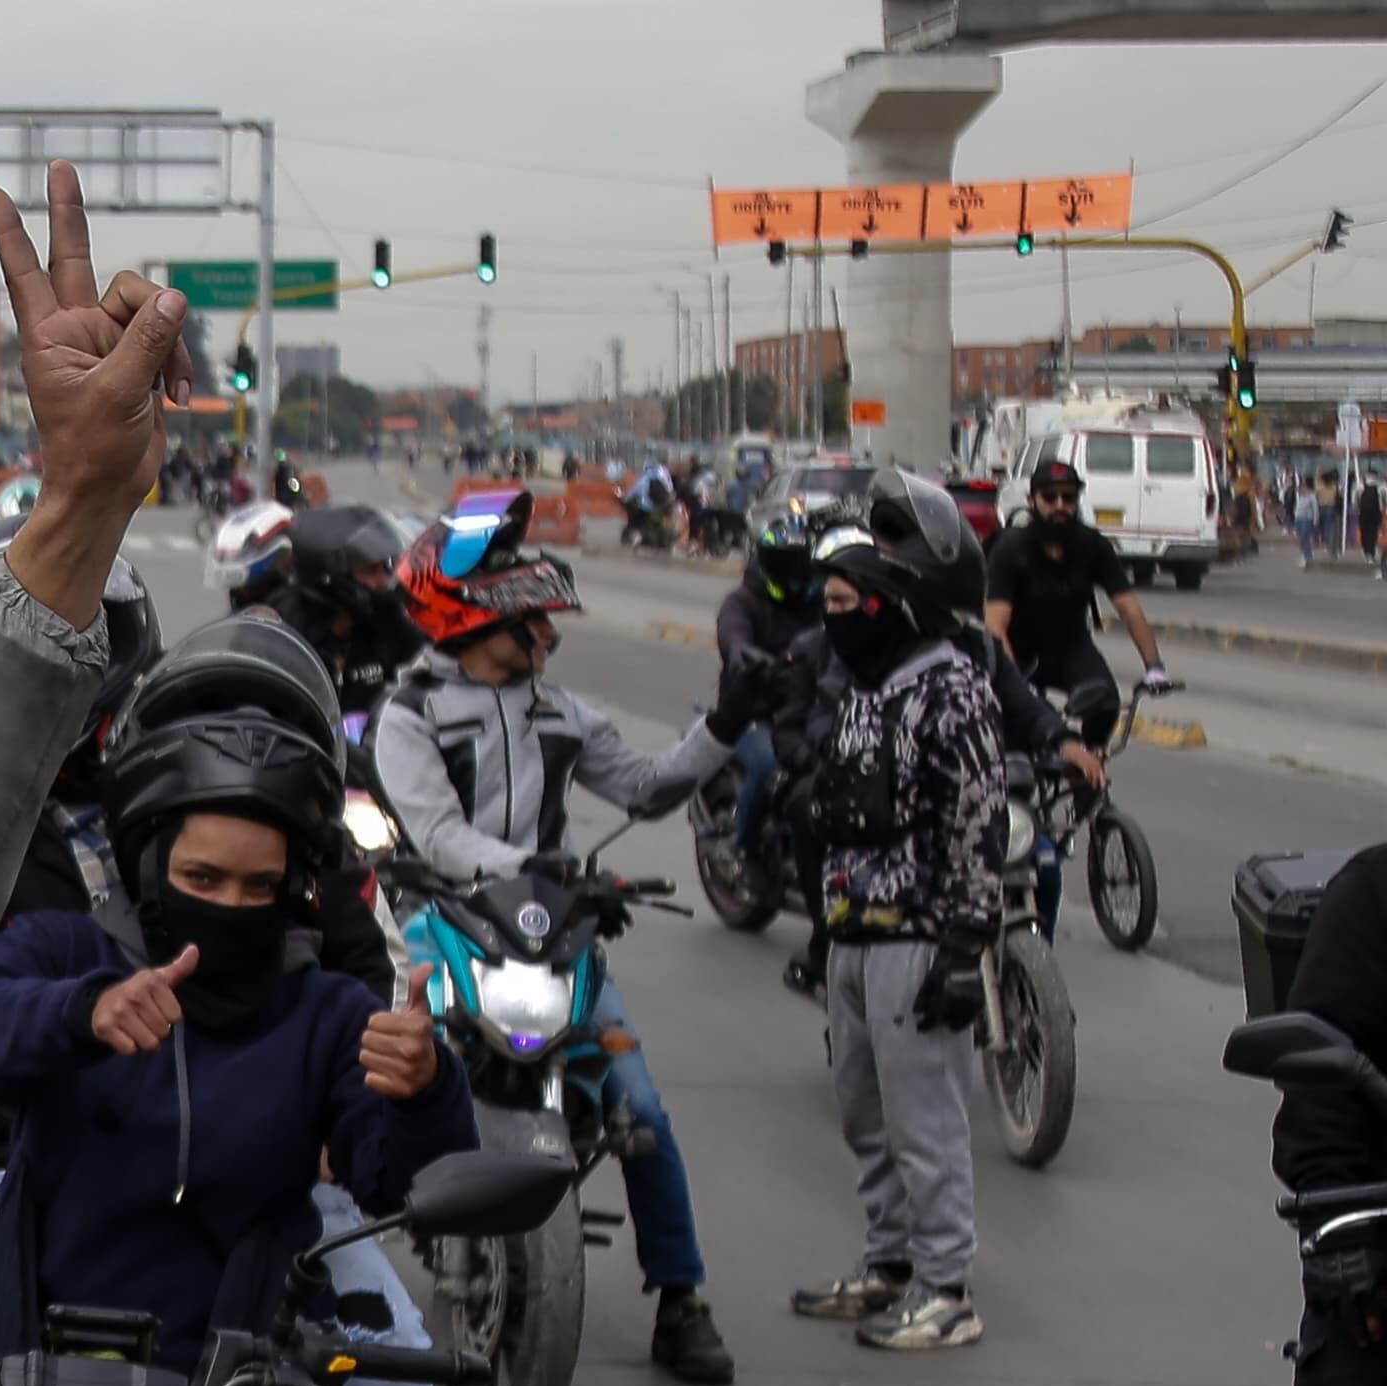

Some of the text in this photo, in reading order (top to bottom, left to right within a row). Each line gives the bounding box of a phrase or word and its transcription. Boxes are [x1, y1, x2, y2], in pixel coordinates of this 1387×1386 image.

[948, 195, 985, 210] SUR
[1058, 191, 1094, 206] SUR
[732, 202, 793, 216] ORIENTE
[841, 200, 902, 213] ORIENTE
